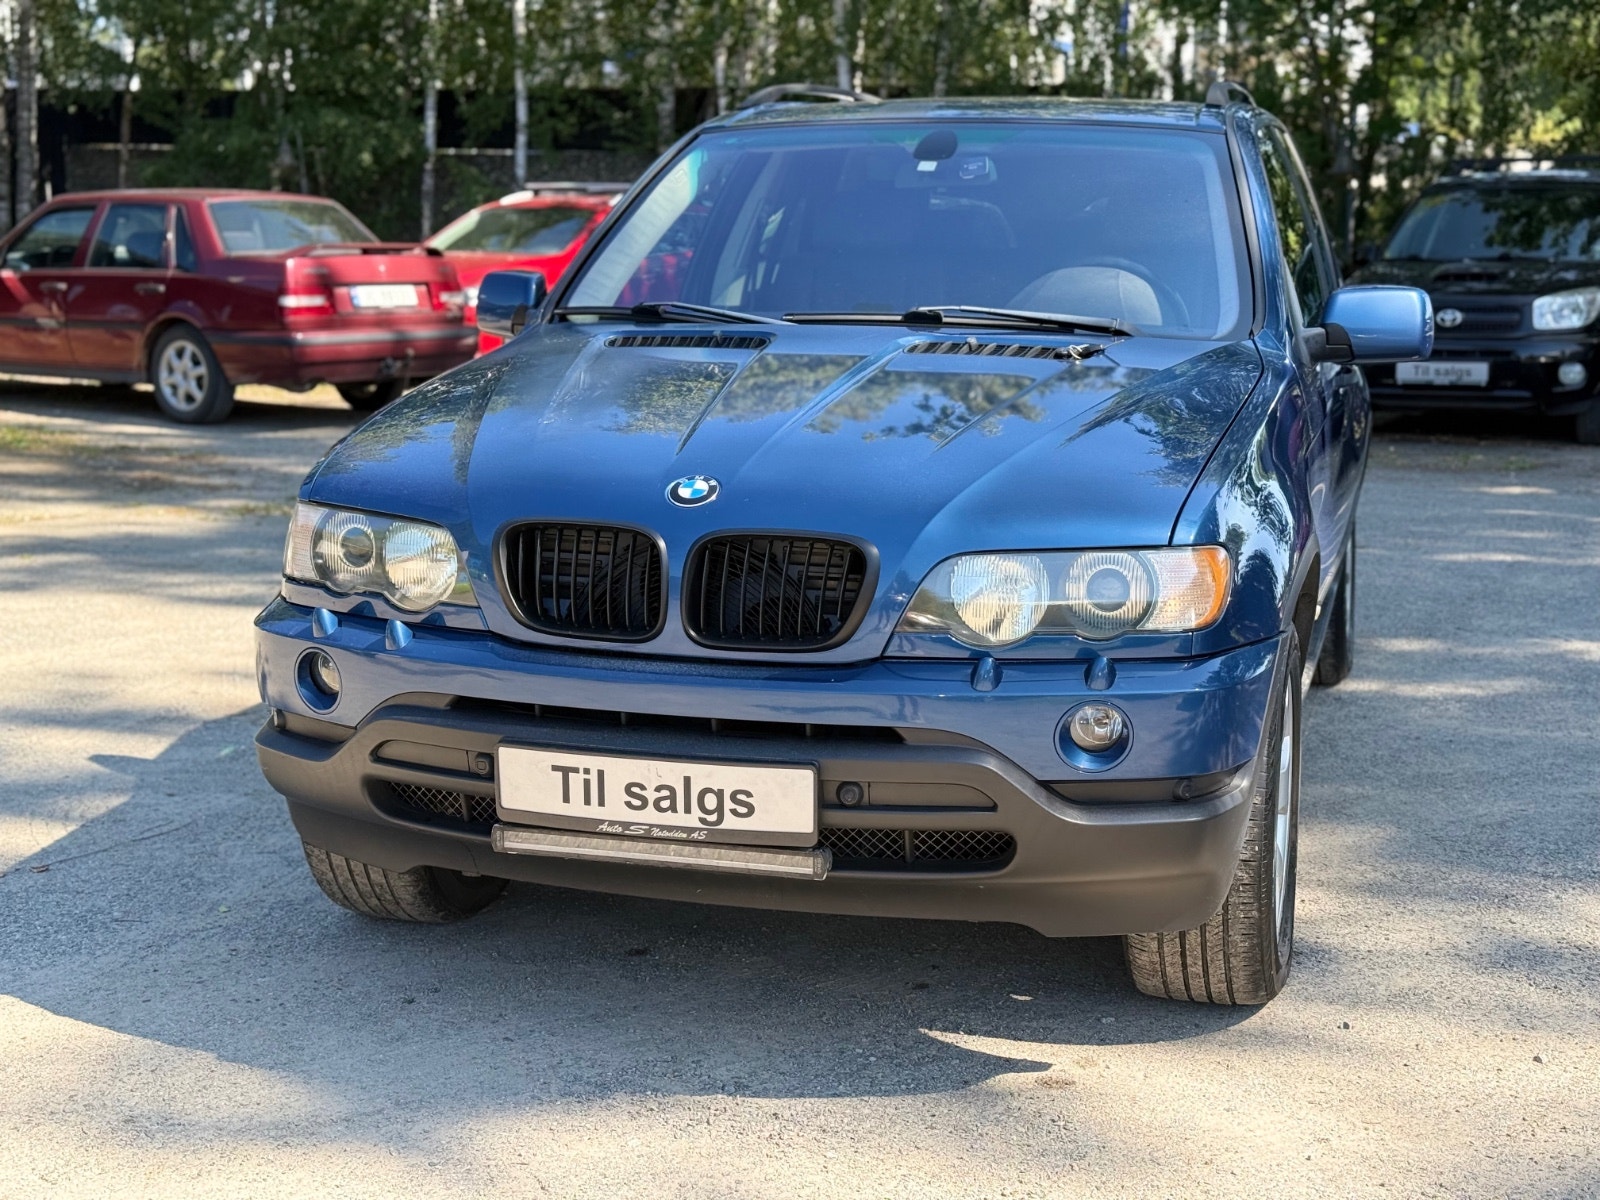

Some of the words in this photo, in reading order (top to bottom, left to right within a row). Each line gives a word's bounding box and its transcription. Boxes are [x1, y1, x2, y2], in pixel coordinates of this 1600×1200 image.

[551, 764, 606, 808] Til
[623, 775, 756, 827] salgs
[596, 821, 623, 833] Auto
[650, 827, 688, 839] Notodden
[689, 830, 708, 840] AS
